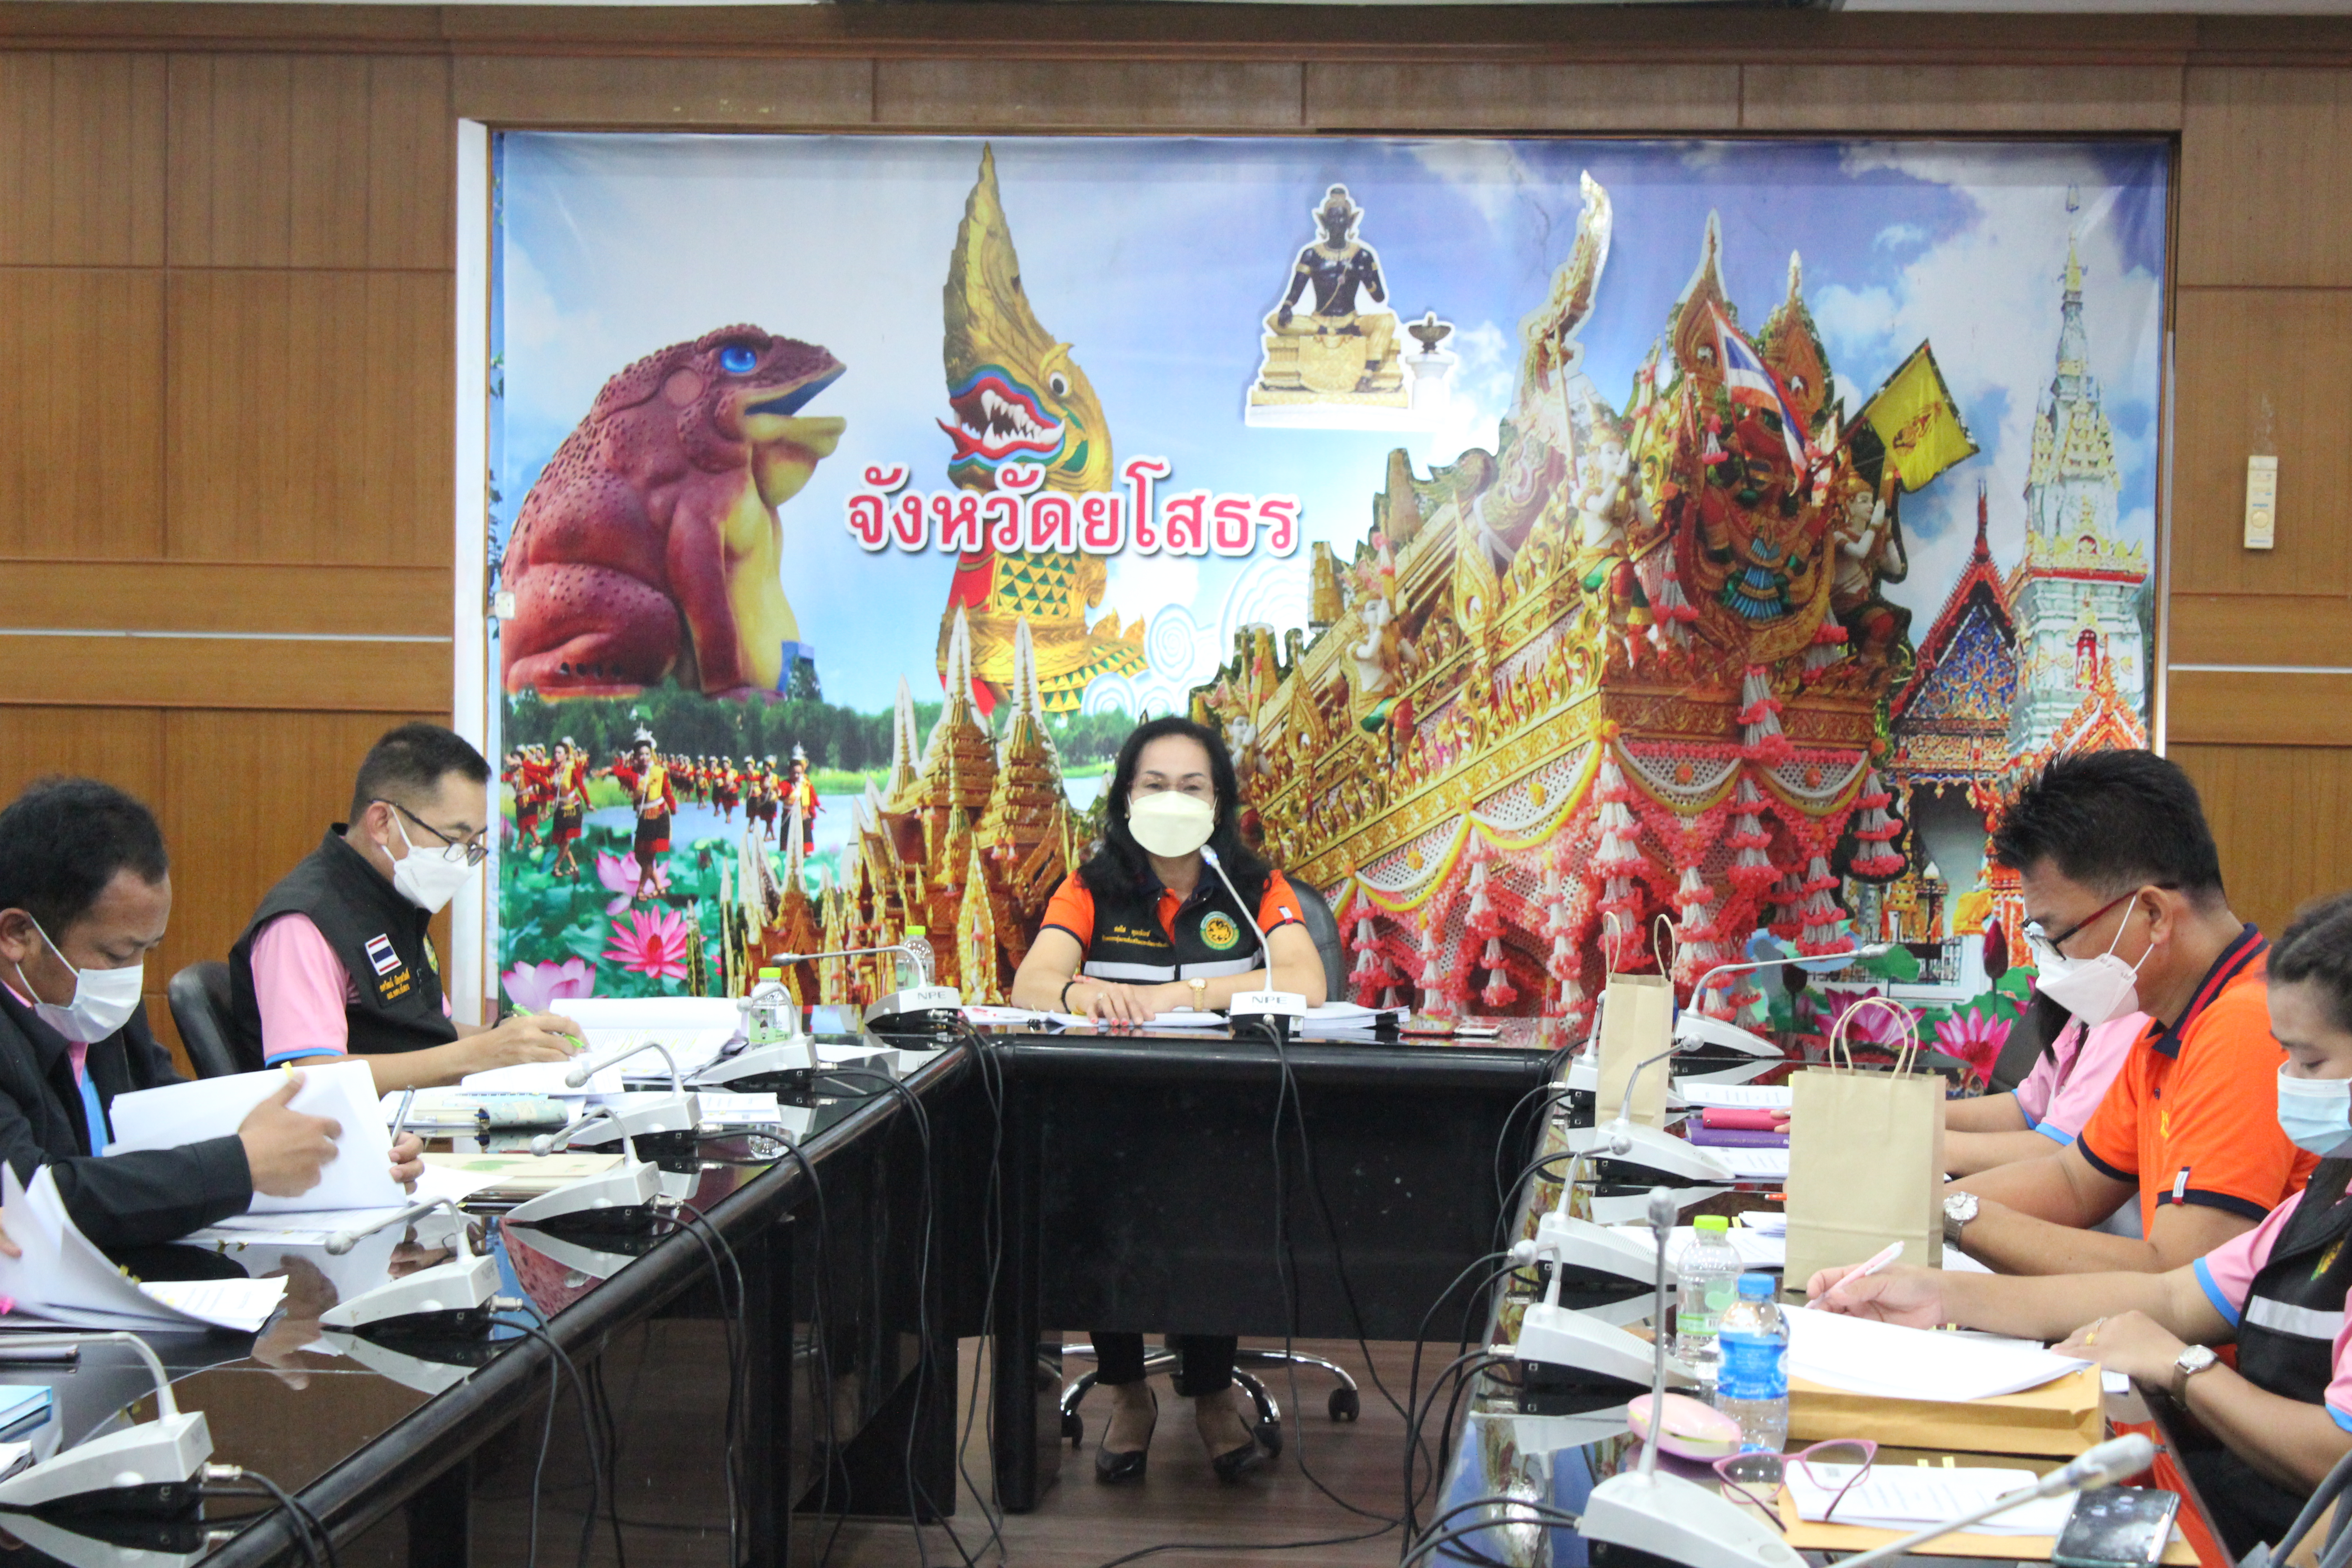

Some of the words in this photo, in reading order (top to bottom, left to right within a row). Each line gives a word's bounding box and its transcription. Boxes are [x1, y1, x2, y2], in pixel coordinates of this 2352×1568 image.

[848, 459, 1296, 549] จังหวัดยโสธร
[917, 991, 946, 1000] NPE
[1252, 996, 1288, 1004] NPE
